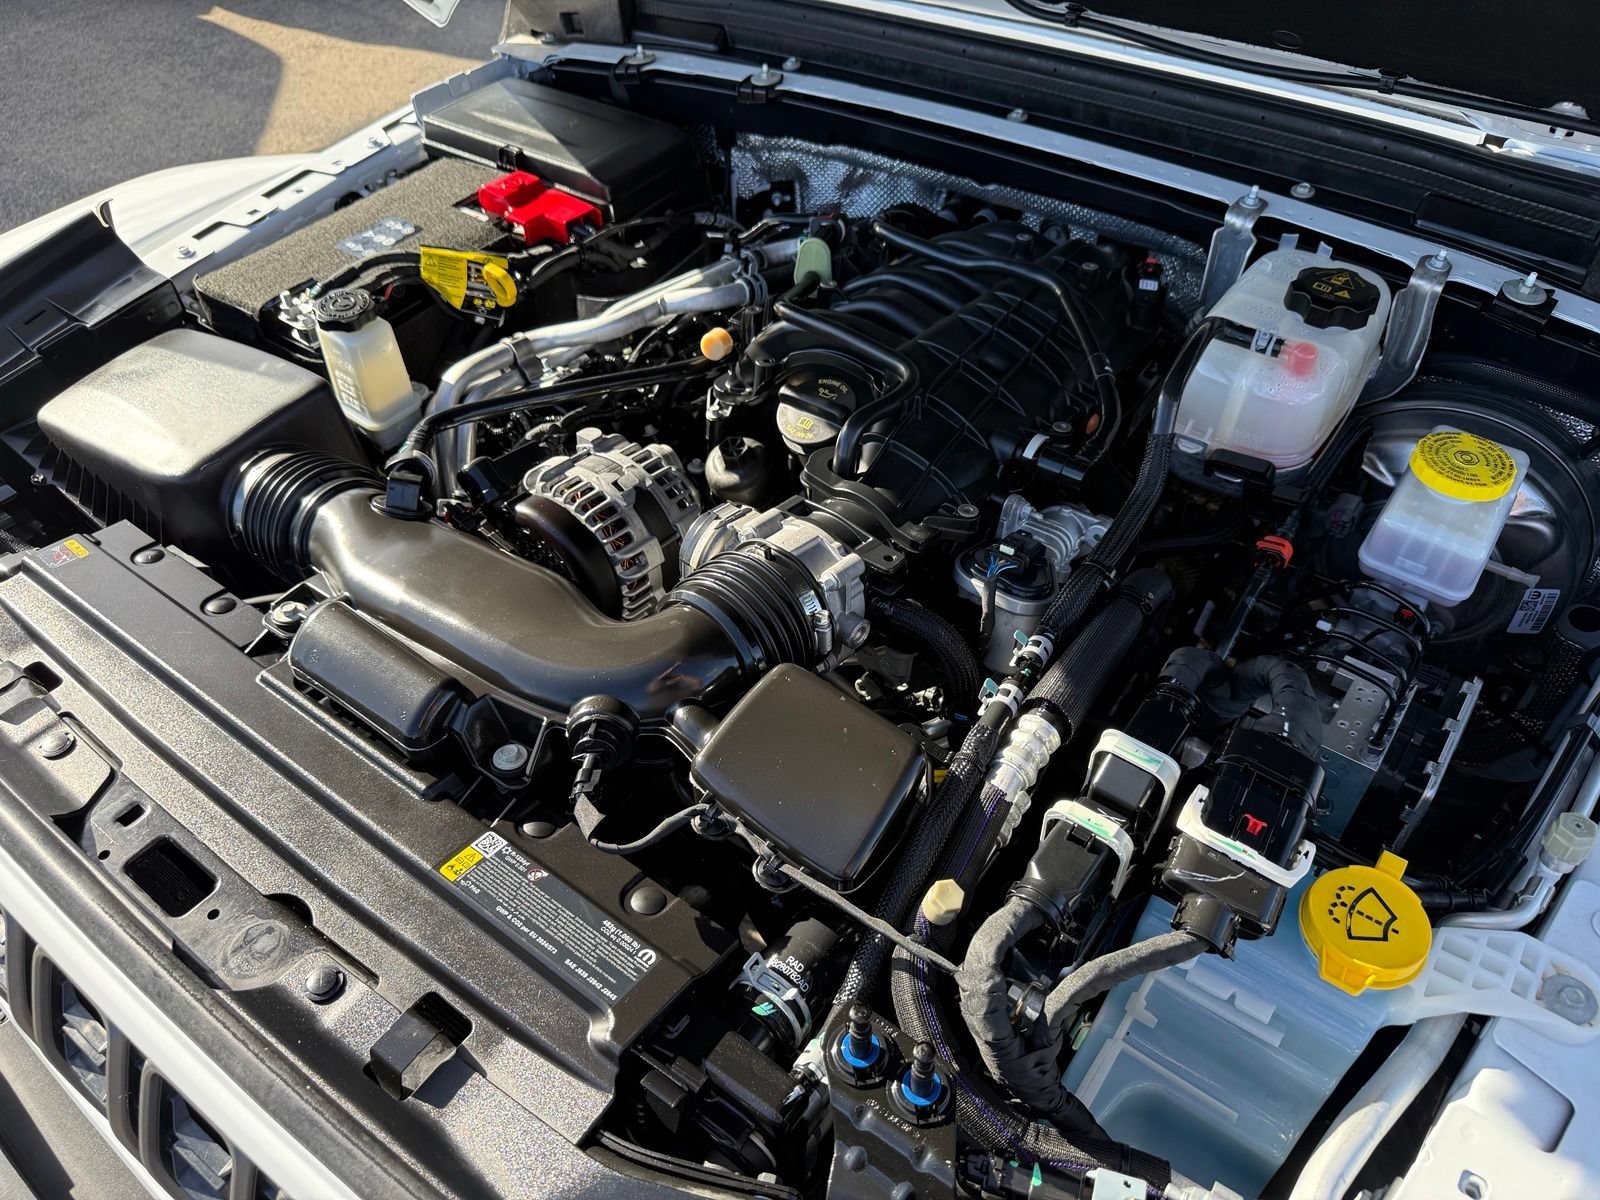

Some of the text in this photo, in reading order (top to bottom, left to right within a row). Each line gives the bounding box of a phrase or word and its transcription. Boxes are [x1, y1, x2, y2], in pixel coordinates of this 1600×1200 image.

[818, 378, 849, 394] ENGINE OIL
[505, 855, 517, 864] GWP
[469, 885, 481, 894] PAG
[496, 906, 509, 915] GWP
[511, 918, 523, 927] CO2
[520, 925, 530, 933] per
[529, 931, 538, 939] EU
[536, 937, 558, 954] 2024/573
[600, 926, 613, 936] CO2
[630, 941, 641, 950] lb)
[564, 959, 577, 969] SAE
[575, 968, 588, 978] J639
[786, 955, 804, 973] RAD
